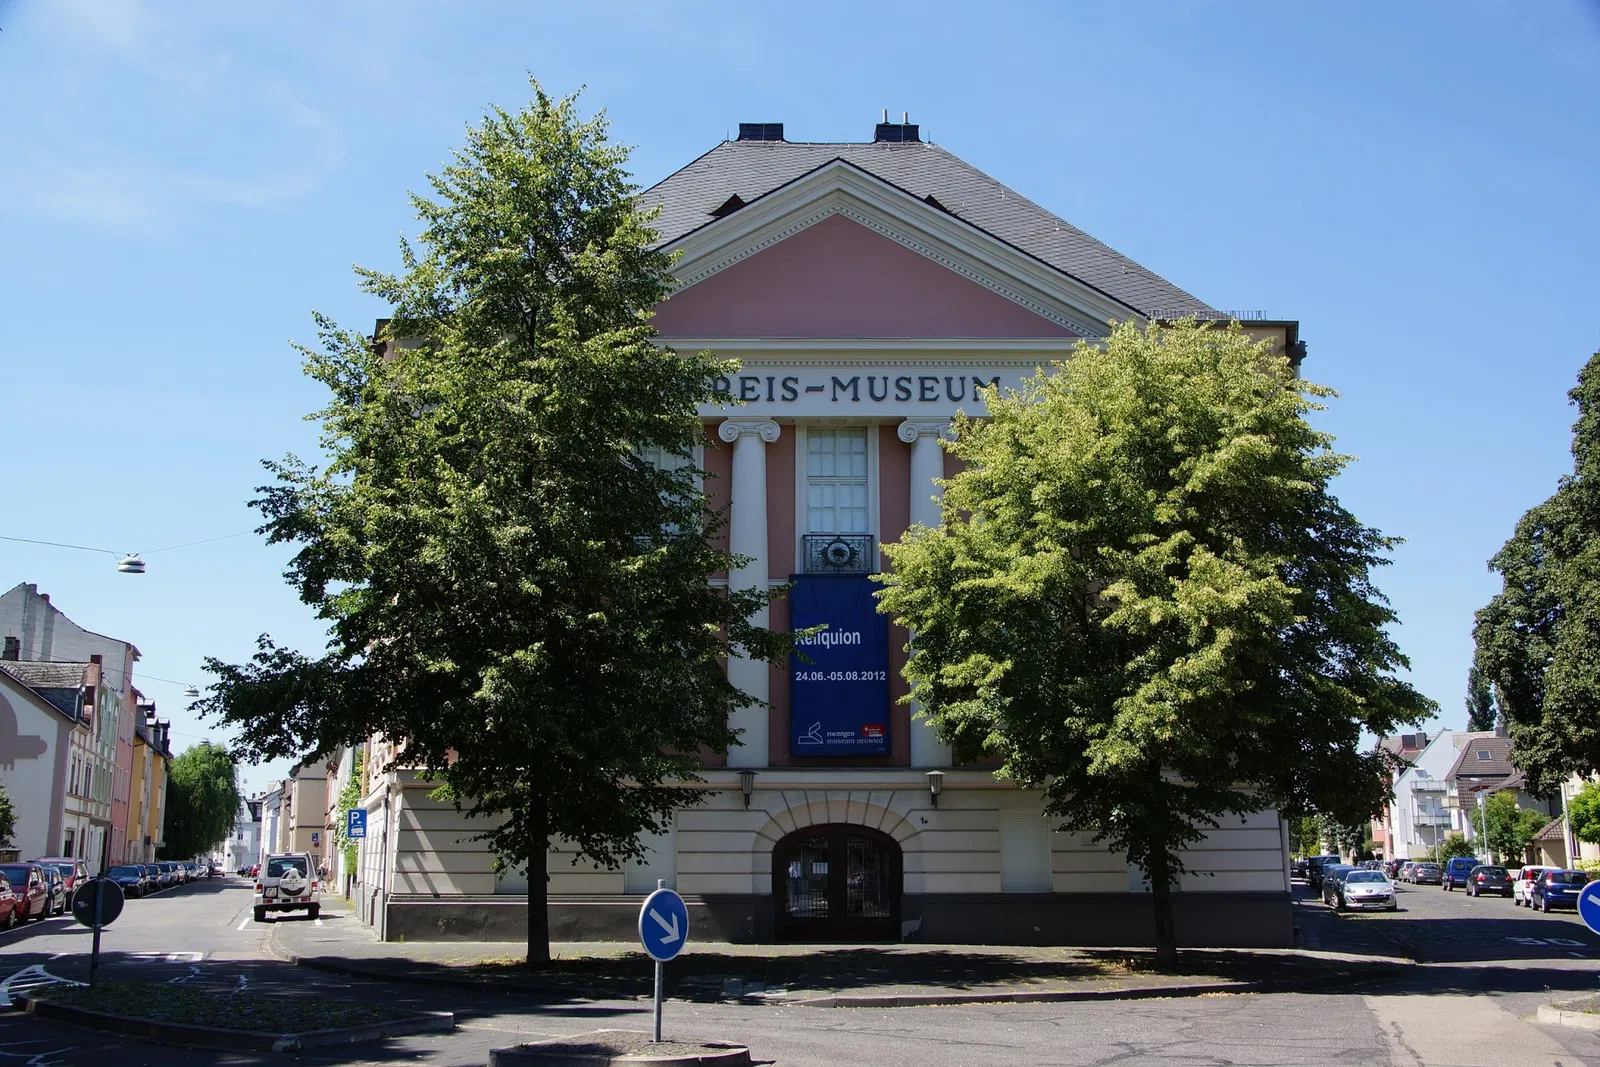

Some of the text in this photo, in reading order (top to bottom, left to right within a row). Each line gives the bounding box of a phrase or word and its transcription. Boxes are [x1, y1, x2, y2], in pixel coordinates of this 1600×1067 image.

[704, 376, 1001, 401] REIS-MUSEUM
[795, 671, 886, 681] 24.06.-05.08.2012
[856, 736, 884, 744] neuwied
[351, 811, 360, 824] P
